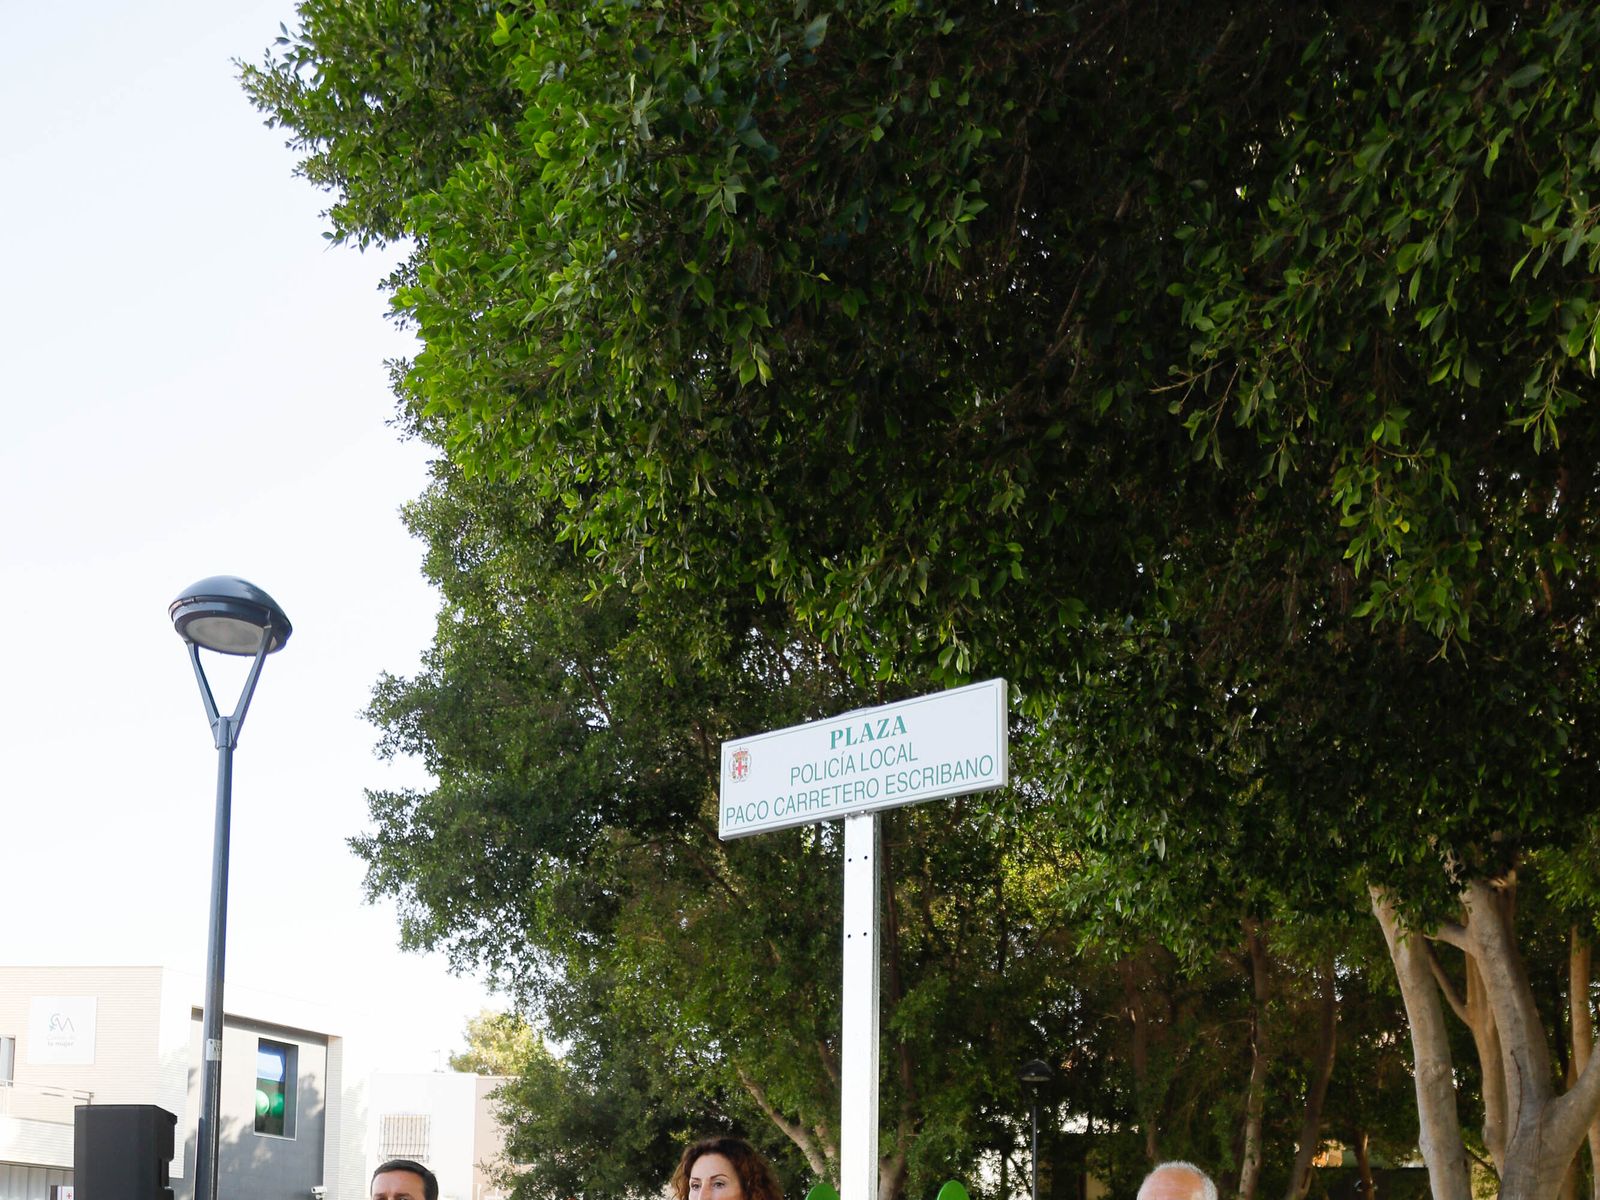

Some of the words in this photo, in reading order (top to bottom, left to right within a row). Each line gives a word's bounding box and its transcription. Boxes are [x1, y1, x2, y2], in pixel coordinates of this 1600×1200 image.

[830, 715, 908, 750] PLAZA
[790, 751, 856, 786] POLICÍA
[861, 742, 918, 771] LOCAL
[726, 800, 769, 826] PACO
[774, 778, 879, 816] CARRETERO
[886, 754, 993, 794] ESCRIBANO
